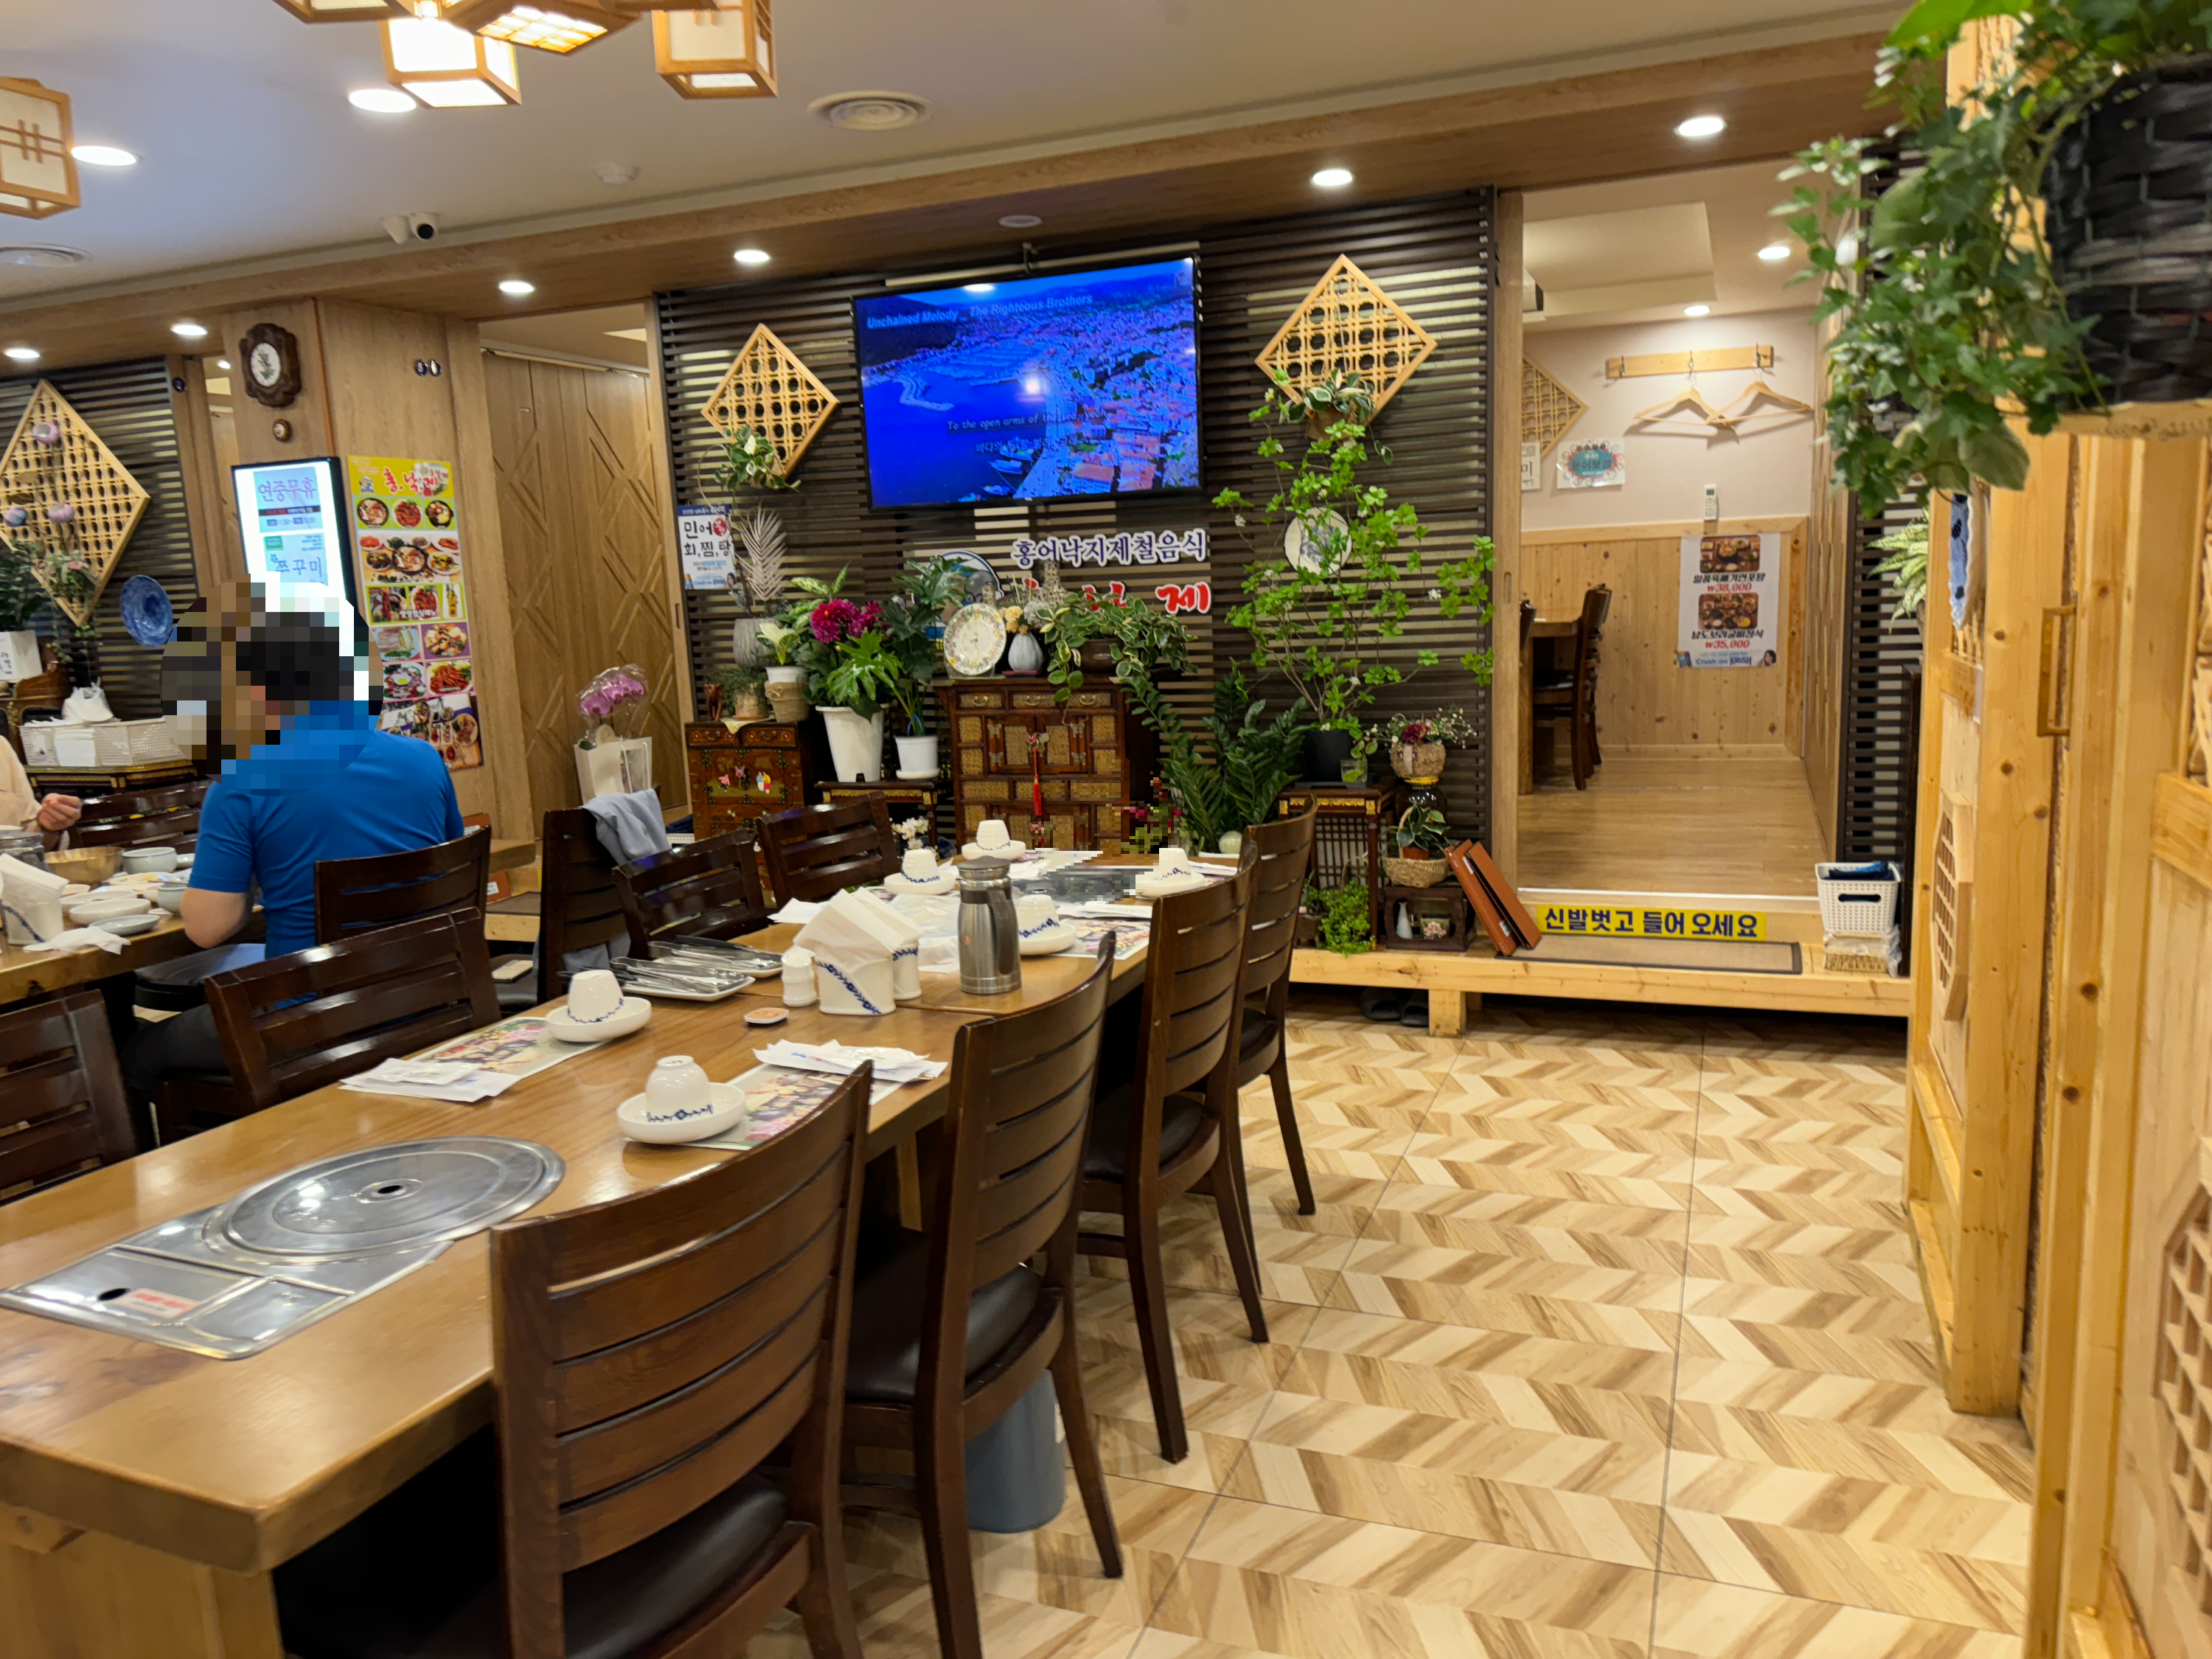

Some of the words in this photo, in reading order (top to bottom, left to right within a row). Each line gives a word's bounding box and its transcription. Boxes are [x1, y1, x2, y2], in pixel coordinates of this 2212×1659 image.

[867, 313, 919, 329] Unchained
[922, 310, 958, 324] Melody
[970, 305, 987, 316] The
[989, 299, 1043, 316] Righteous
[1046, 295, 1092, 309] Brothers
[962, 419, 976, 429] the
[1004, 417, 1025, 426] arms
[258, 477, 317, 502] 연중무휴
[684, 520, 713, 539] 민어
[1013, 530, 1204, 566] 홍어낙지제철음식
